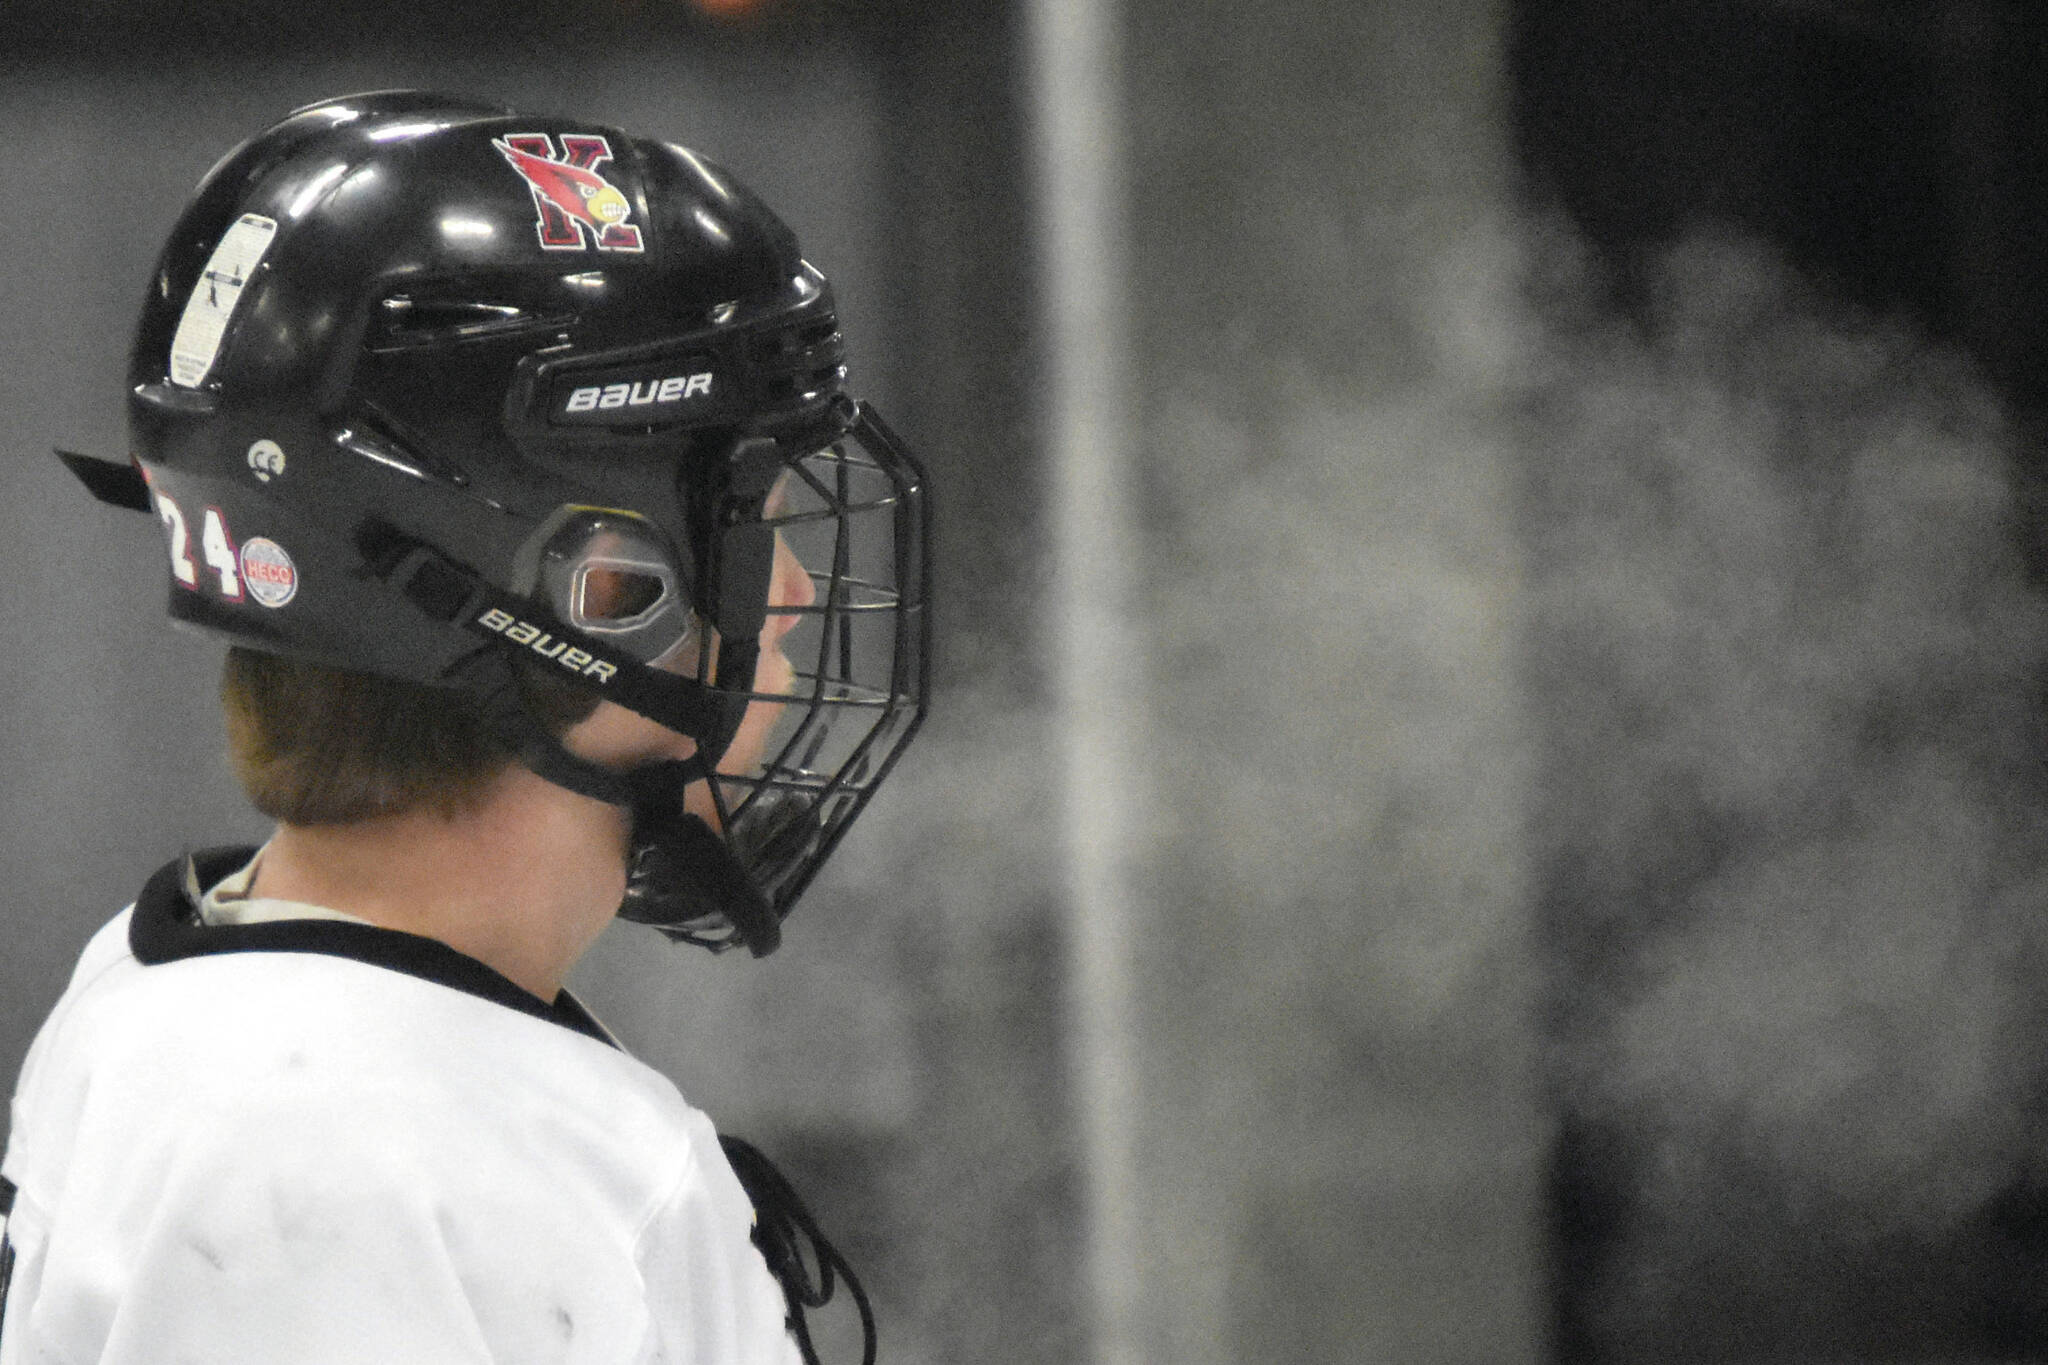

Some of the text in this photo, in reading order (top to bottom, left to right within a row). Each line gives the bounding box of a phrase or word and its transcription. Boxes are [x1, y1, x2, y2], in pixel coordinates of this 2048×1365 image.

[566, 373, 713, 412] BAUER
[155, 490, 244, 602] 24
[478, 608, 618, 684] BAUER
